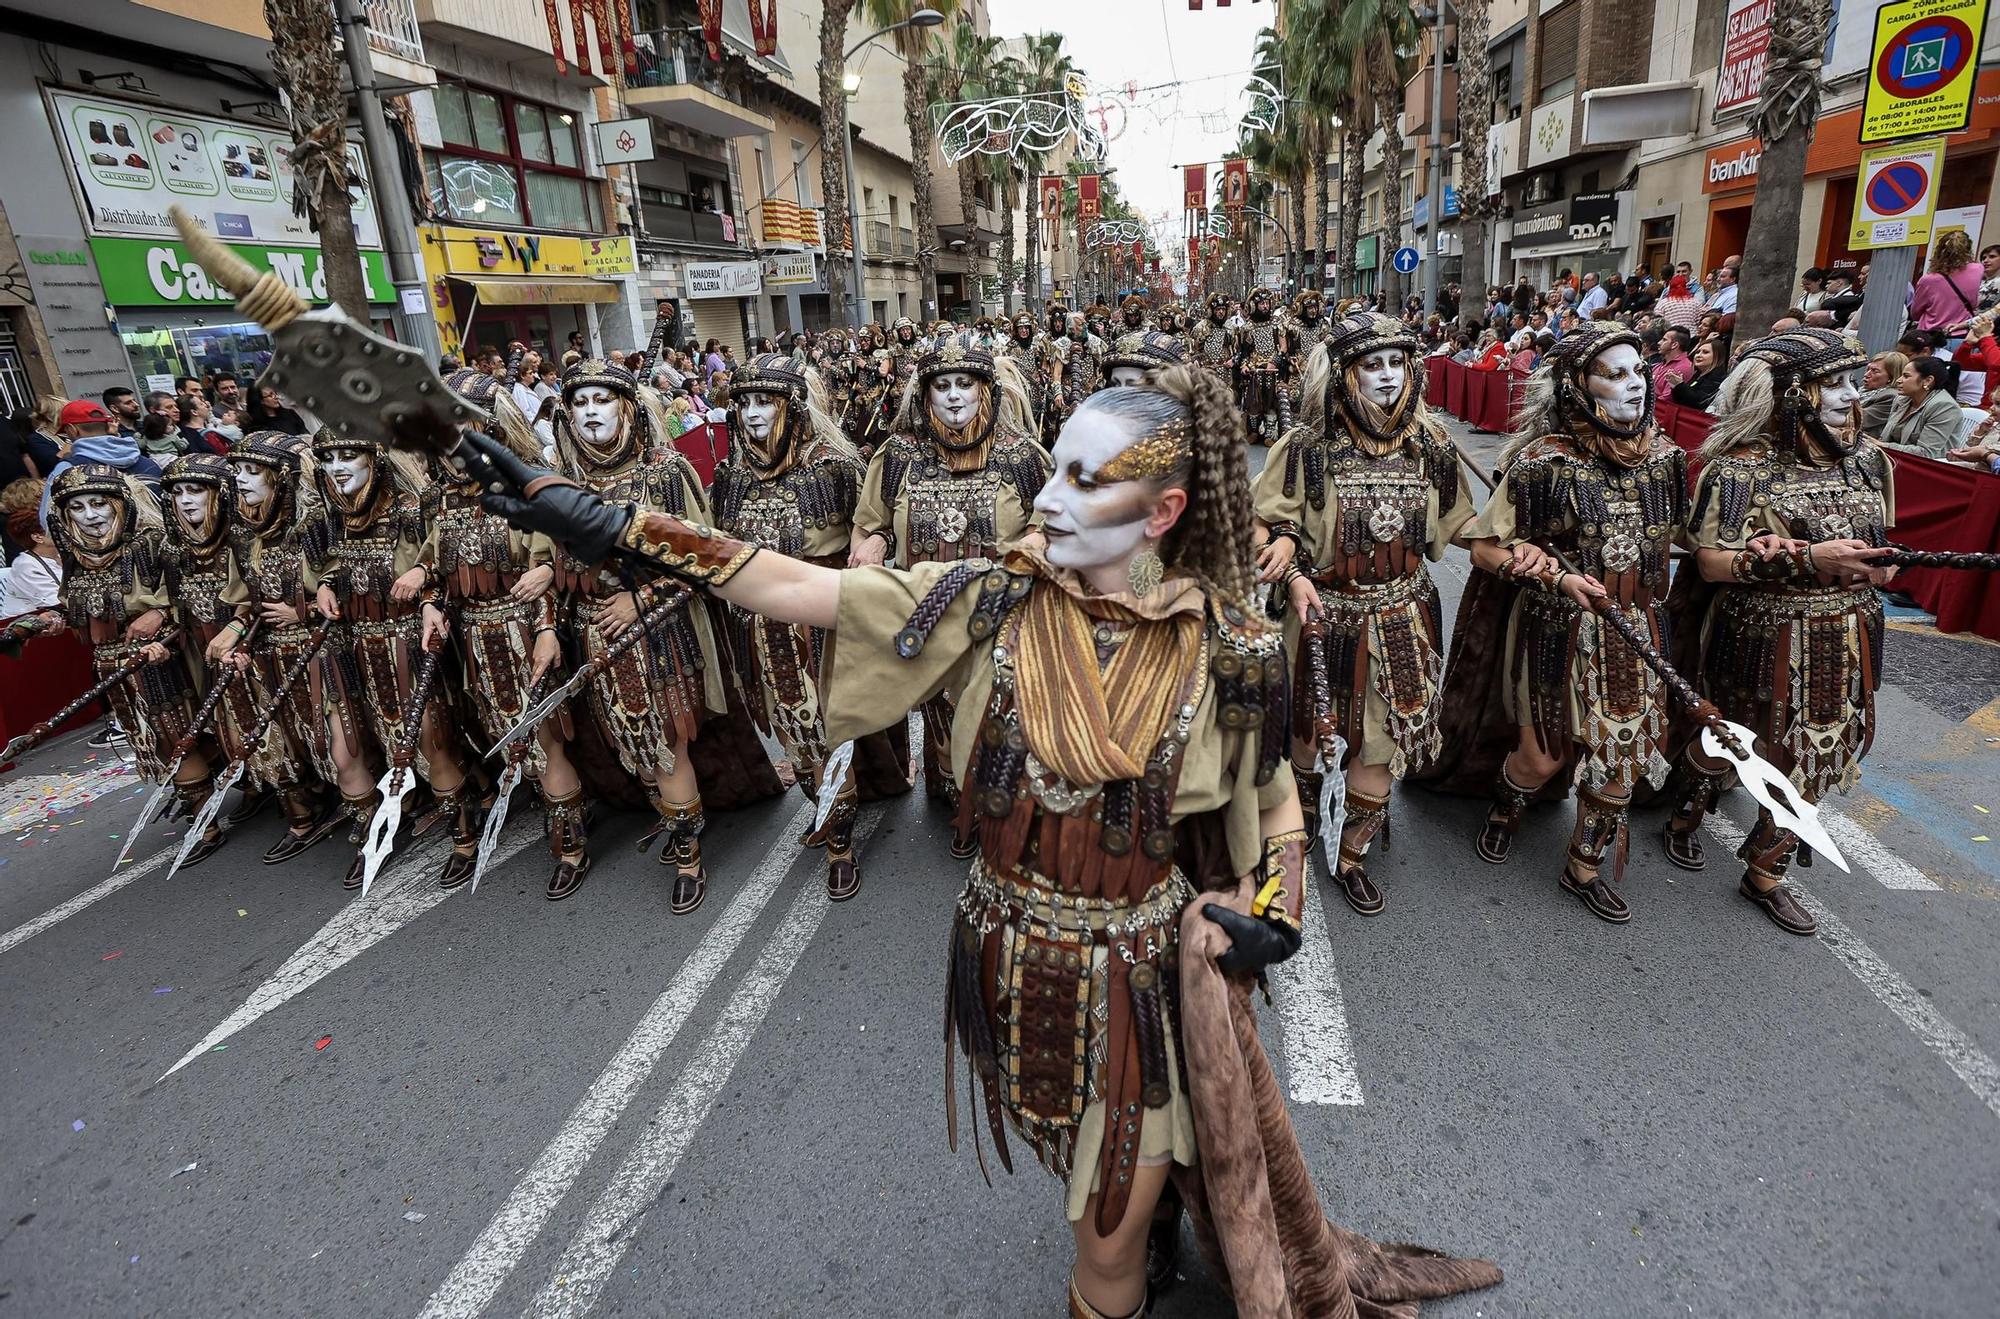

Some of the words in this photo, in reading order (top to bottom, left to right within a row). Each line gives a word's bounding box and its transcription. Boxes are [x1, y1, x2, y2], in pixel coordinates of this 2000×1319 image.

[1887, 13, 1916, 24] CARGA
[1927, 0, 1977, 15] DESCARGA
[1728, 15, 1741, 41] SE
[1888, 94, 1945, 110] LABORABLES
[1868, 115, 1879, 123] de
[1880, 111, 1904, 120] 08:00
[1913, 106, 1937, 116] 14:00
[1938, 102, 1964, 111] horas
[1867, 124, 1877, 132] de
[1880, 121, 1902, 130] 17:00
[1912, 115, 1935, 125] 20:00
[1937, 112, 1962, 121] horas
[1871, 130, 1894, 138] Tiempo
[100, 206, 157, 227] Distribuidor
[1840, 259, 1857, 268] banco
[689, 269, 720, 279] PANADERIA
[693, 281, 721, 291] BOLLERIA
